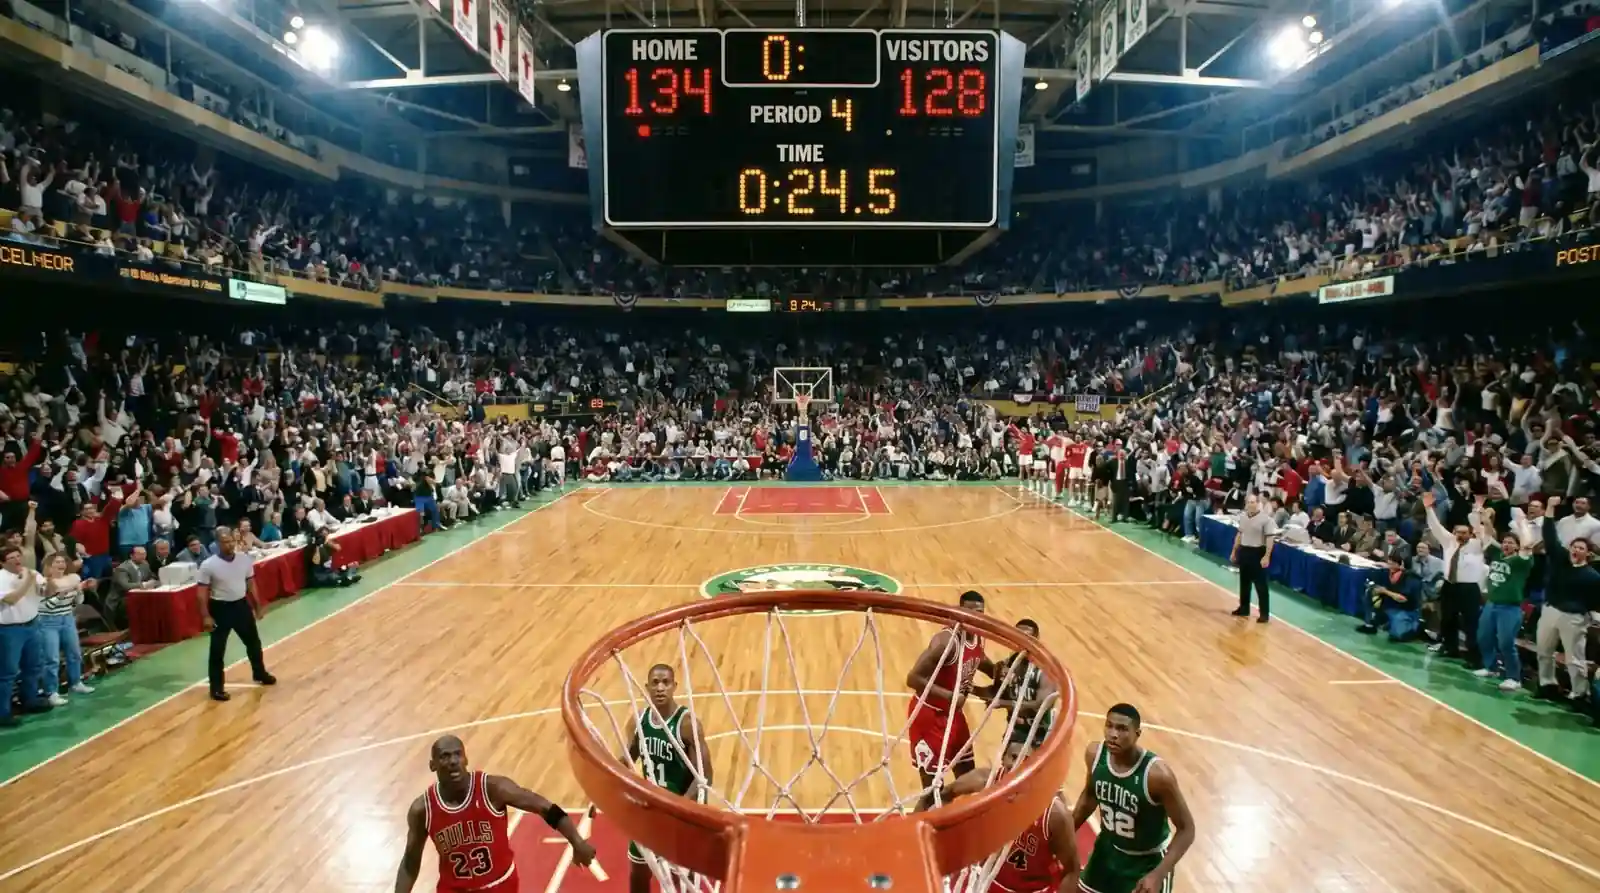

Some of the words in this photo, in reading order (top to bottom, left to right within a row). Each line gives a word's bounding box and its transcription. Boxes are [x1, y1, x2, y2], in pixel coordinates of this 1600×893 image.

[632, 39, 698, 61] HOME
[886, 39, 989, 62] VISITORS
[623, 68, 713, 116] 134
[899, 68, 986, 116] 128
[750, 105, 822, 125] PERIOD
[831, 98, 853, 132] 4
[777, 144, 824, 163] TIME
[739, 168, 897, 215] 0:24.5
[1095, 779, 1140, 815] CELTICS
[435, 820, 495, 854] BULLS
[1099, 802, 1136, 840] 32
[448, 845, 494, 880] 23
